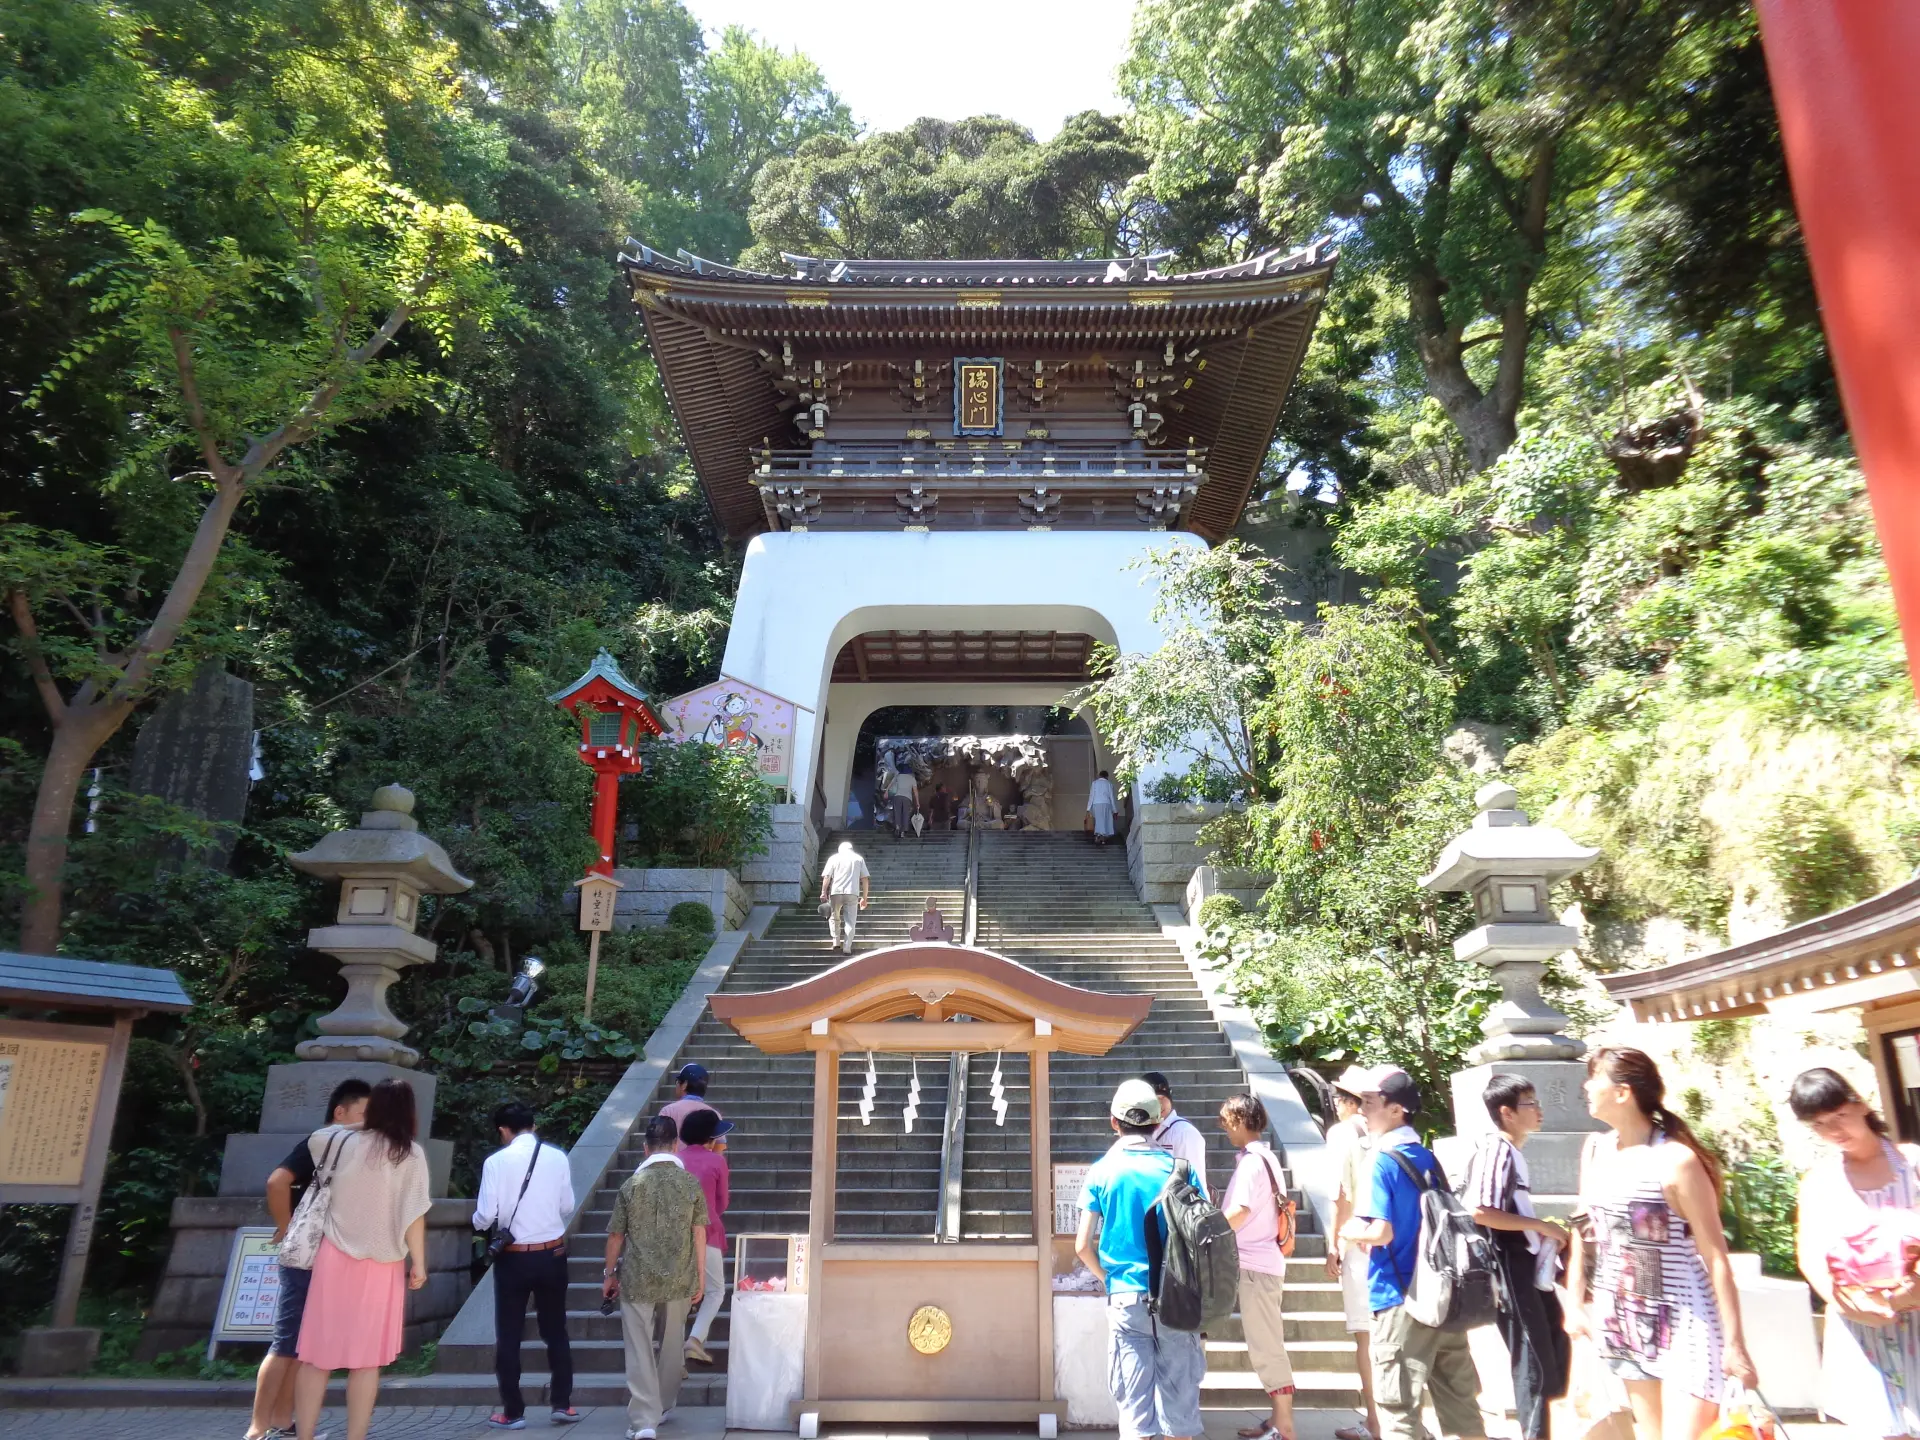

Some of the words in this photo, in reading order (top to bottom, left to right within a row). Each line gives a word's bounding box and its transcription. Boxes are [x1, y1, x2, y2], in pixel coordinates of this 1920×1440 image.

[968, 369, 989, 425] 瑞心門
[795, 1243, 804, 1285] おみくじ
